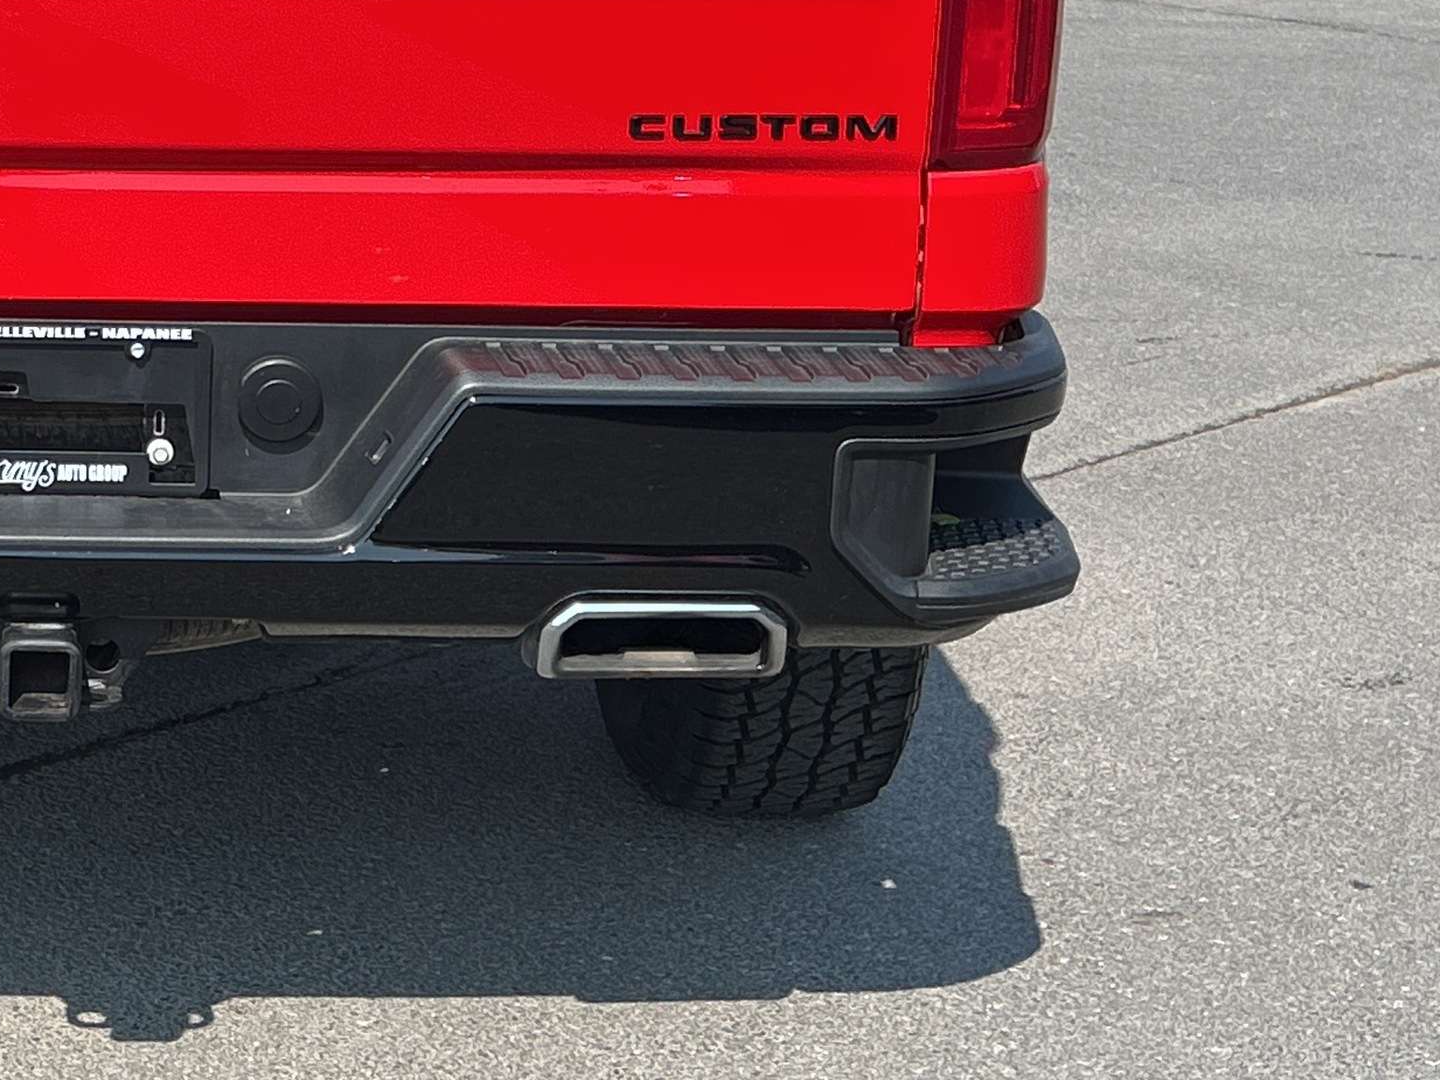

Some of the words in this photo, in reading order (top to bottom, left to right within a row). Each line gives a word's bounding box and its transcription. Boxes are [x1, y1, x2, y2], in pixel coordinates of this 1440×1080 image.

[629, 113, 898, 141] CUSTOM
[102, 328, 192, 340] NAPANEE
[57, 464, 87, 482] AUTO
[88, 465, 127, 482] GROUP
